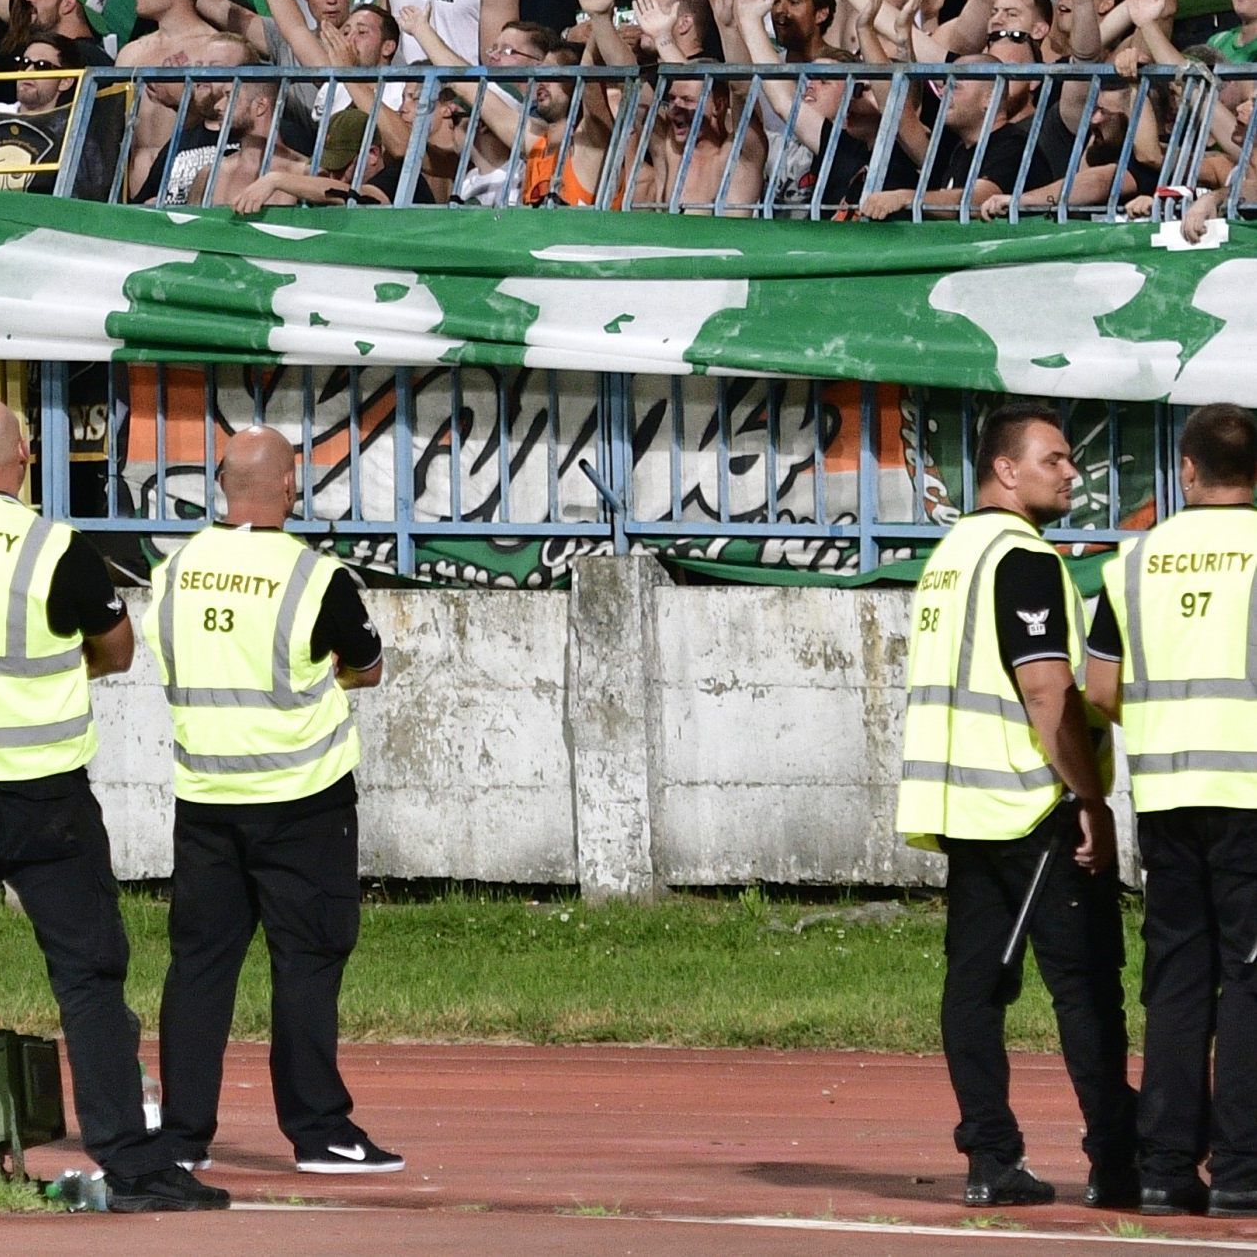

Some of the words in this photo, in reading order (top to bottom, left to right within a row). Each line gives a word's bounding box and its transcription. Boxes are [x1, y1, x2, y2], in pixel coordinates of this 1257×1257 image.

[1147, 551, 1253, 574] SECURITY
[180, 571, 281, 598] SECURITY
[1180, 592, 1213, 618] 97
[203, 607, 235, 633] 83
